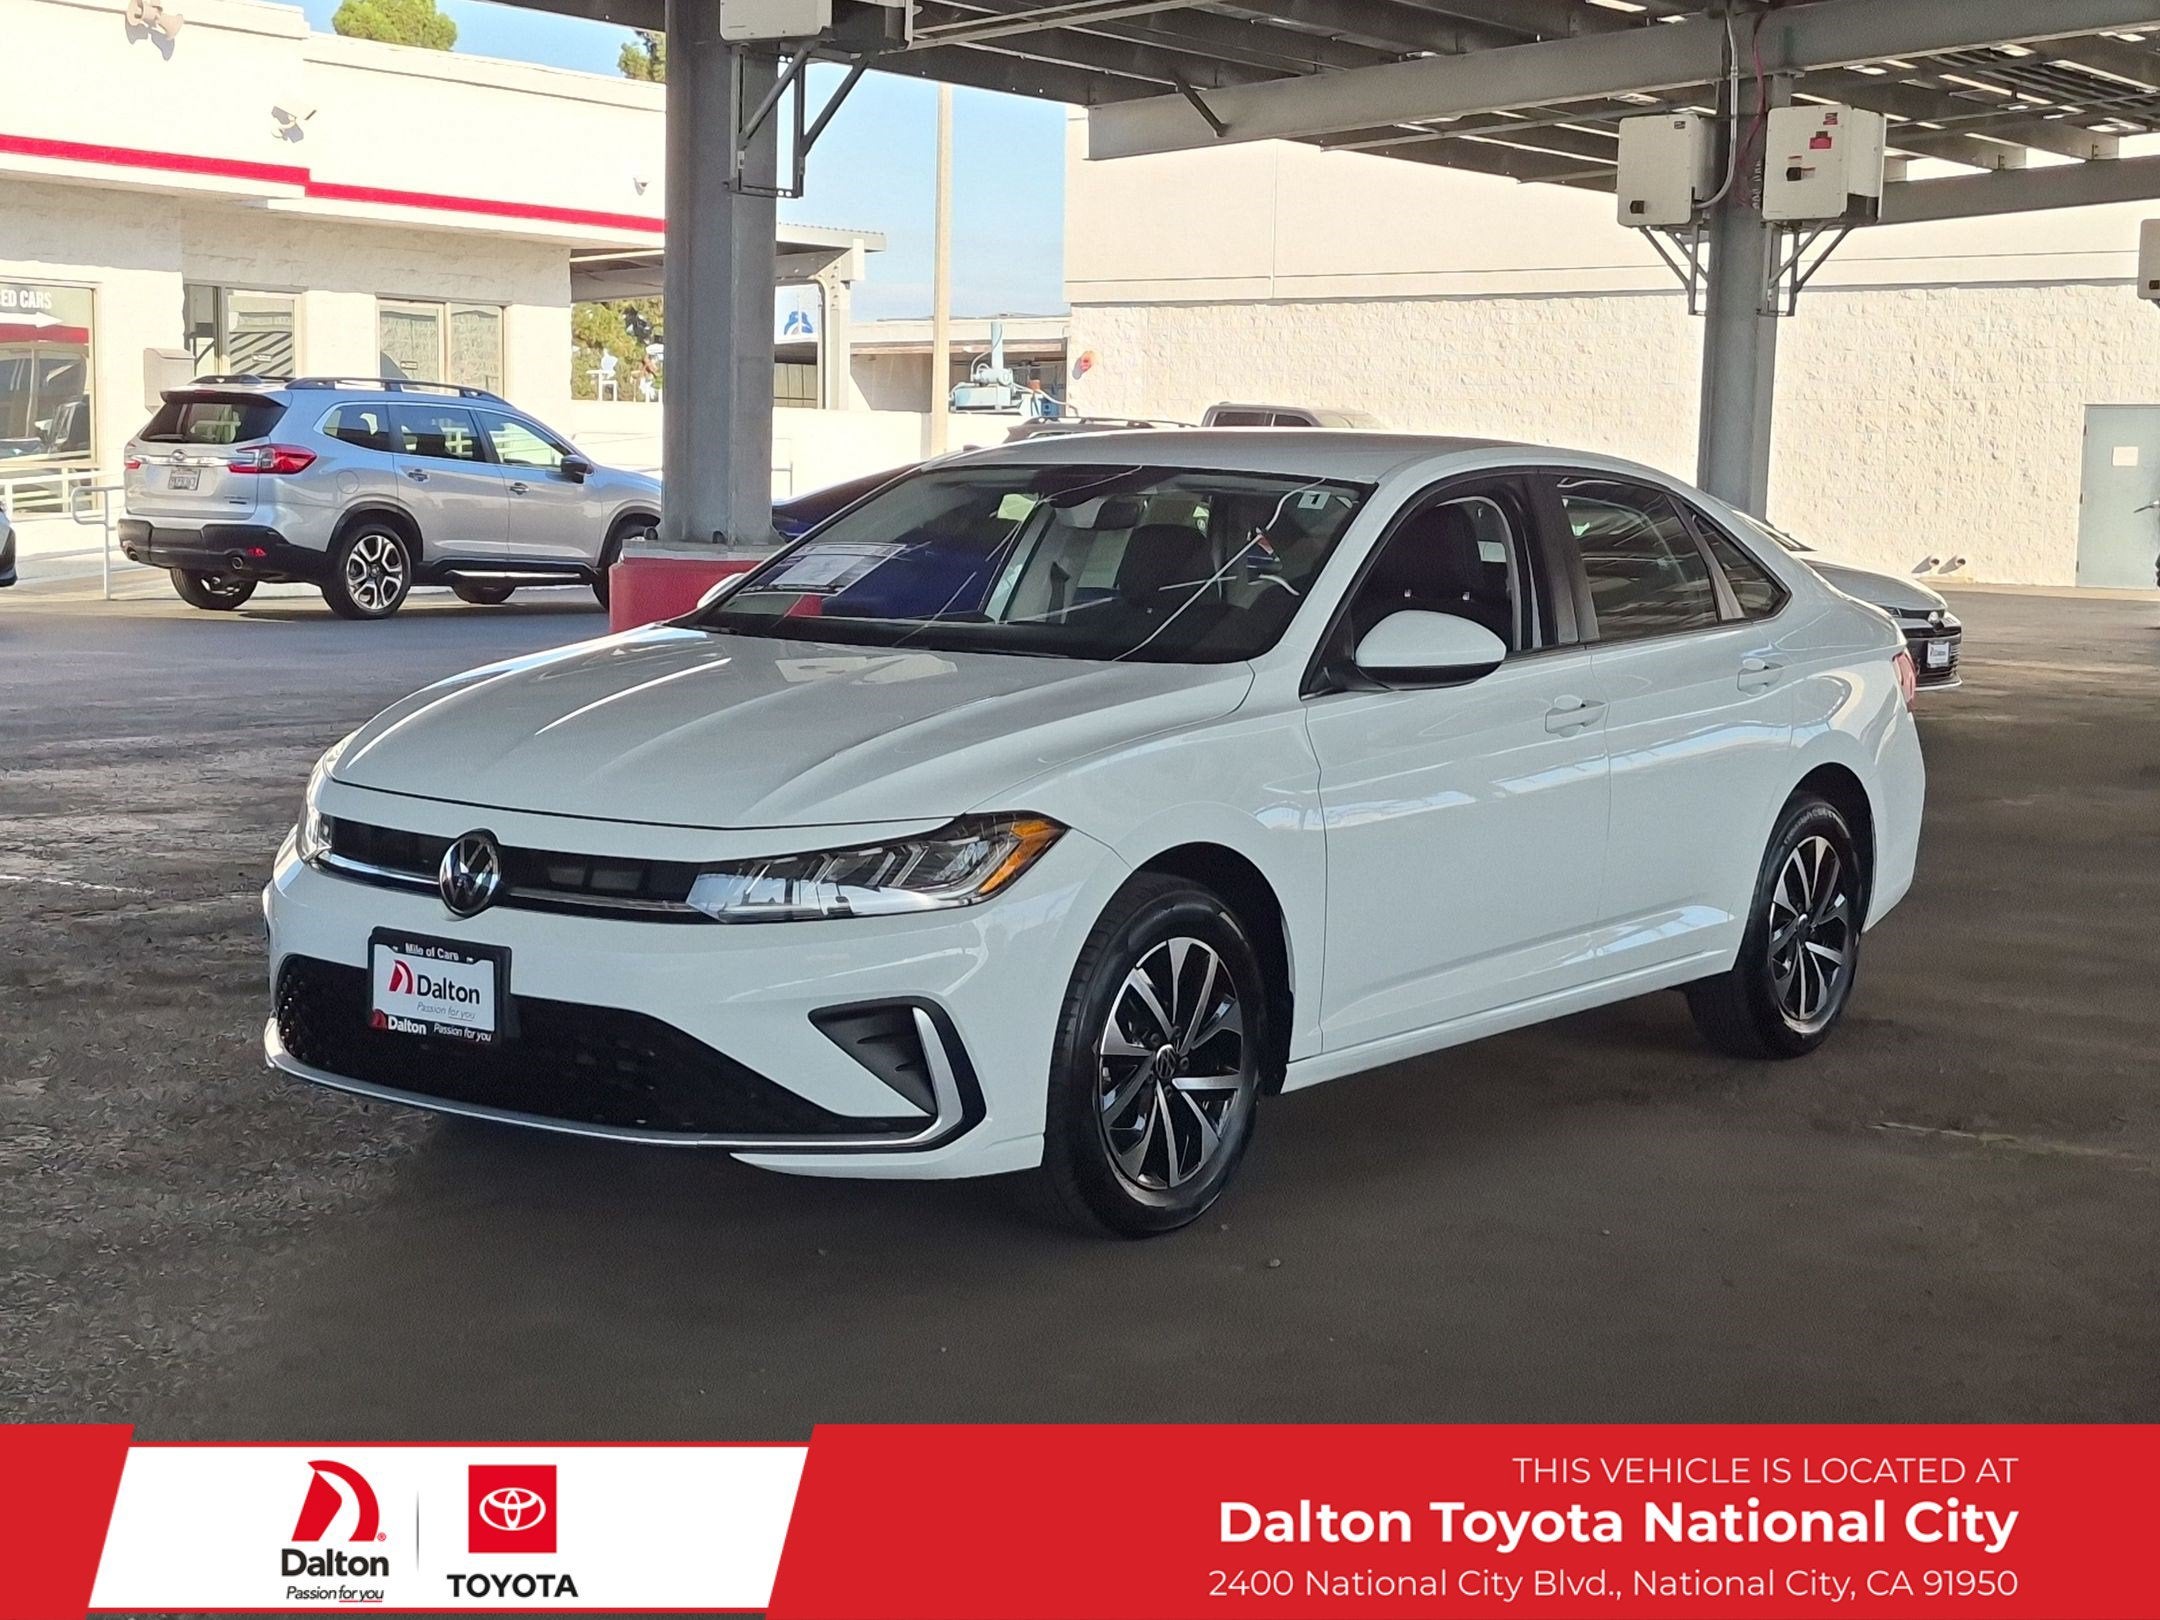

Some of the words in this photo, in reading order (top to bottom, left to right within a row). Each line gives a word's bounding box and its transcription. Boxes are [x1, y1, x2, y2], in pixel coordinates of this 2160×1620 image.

[0, 289, 17, 307] ED
[20, 290, 52, 309] CARS
[425, 946, 435, 957] of
[417, 974, 480, 1005] Dalton
[416, 1001, 447, 1015] Passion
[448, 1005, 460, 1018] for
[461, 1011, 476, 1020] you
[387, 1016, 427, 1035] Dalton
[433, 1022, 463, 1037] Passion
[464, 1027, 476, 1039] for
[476, 1031, 492, 1043] you
